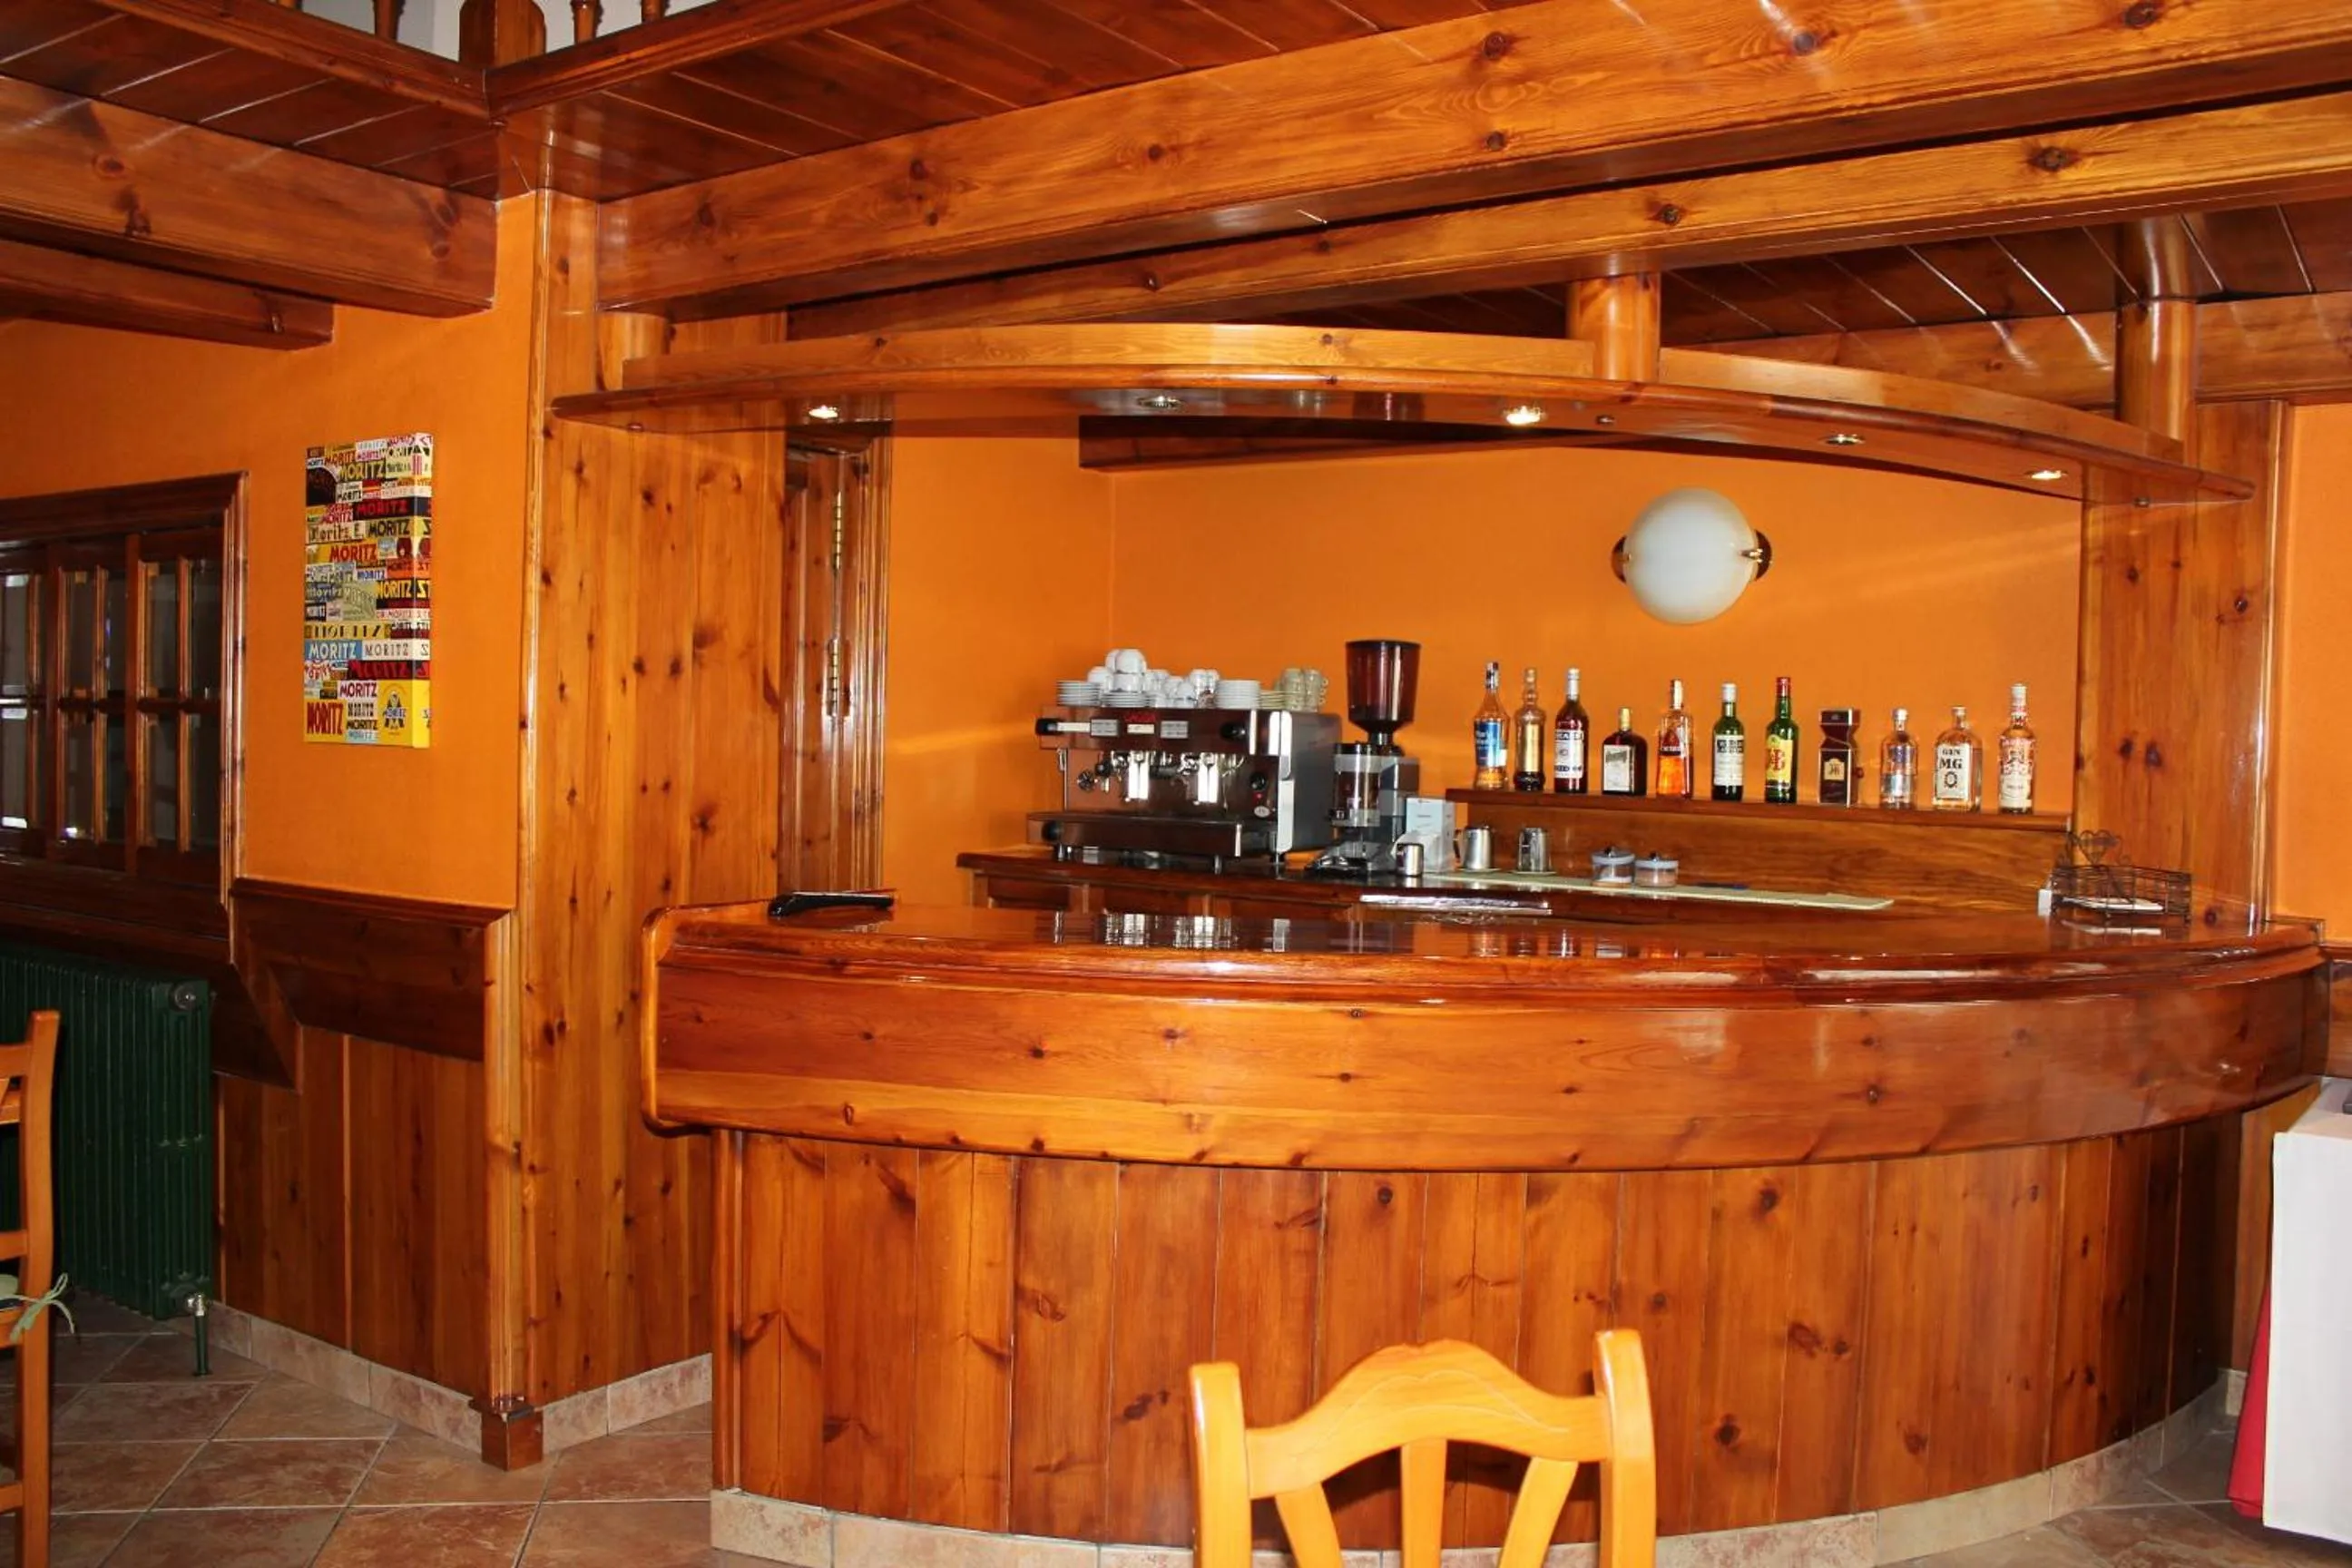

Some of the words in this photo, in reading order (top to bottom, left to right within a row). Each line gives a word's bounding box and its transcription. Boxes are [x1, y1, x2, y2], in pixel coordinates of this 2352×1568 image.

[339, 462, 385, 481] MORITZ
[358, 500, 407, 517] MORITZ
[368, 518, 410, 538] MORITZ
[330, 543, 377, 563] MORITZ
[309, 641, 357, 660] MORITZ
[365, 642, 408, 656] MORITZ
[340, 682, 377, 698] MORITZ
[307, 702, 343, 734] MORITZ
[347, 720, 377, 730] MORITZ
[1939, 758, 1963, 769] MG
